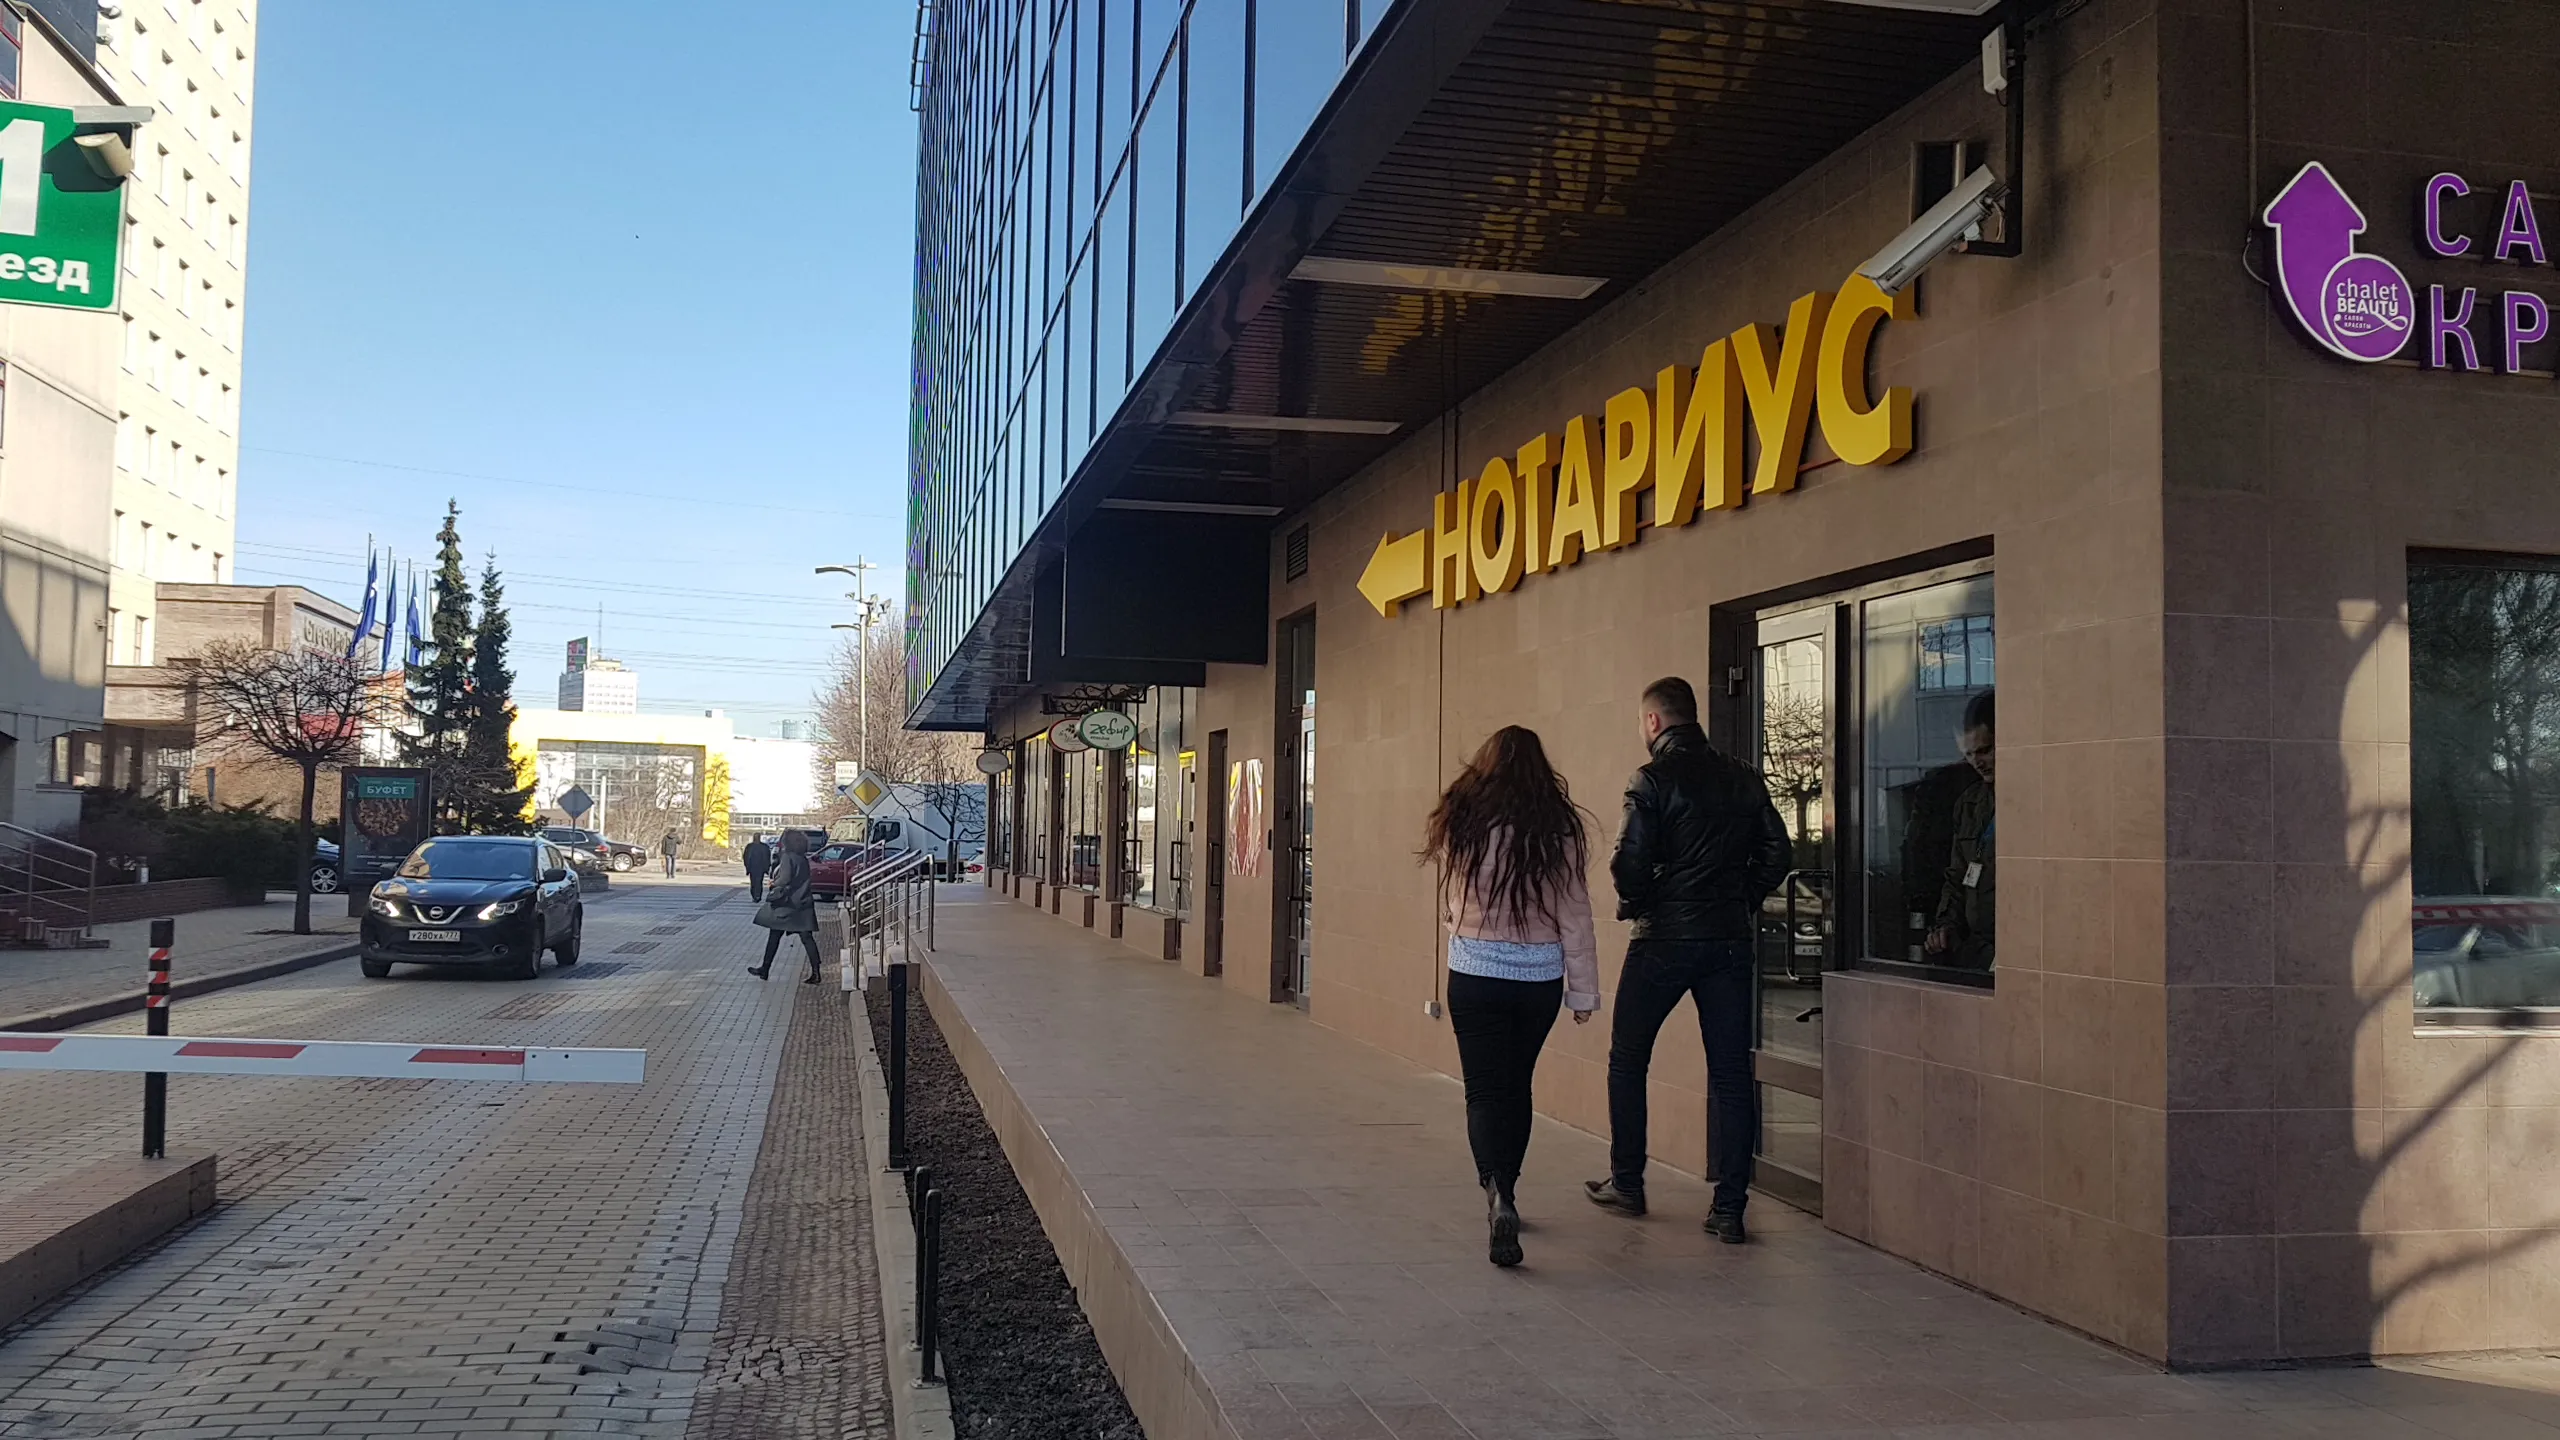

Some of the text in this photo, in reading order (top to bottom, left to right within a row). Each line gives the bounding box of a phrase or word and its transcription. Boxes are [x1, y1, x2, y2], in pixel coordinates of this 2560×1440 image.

[2336, 277, 2398, 301] chalet
[1432, 262, 1917, 609] НОТАРИУС
[366, 785, 407, 795] БУФЕТ
